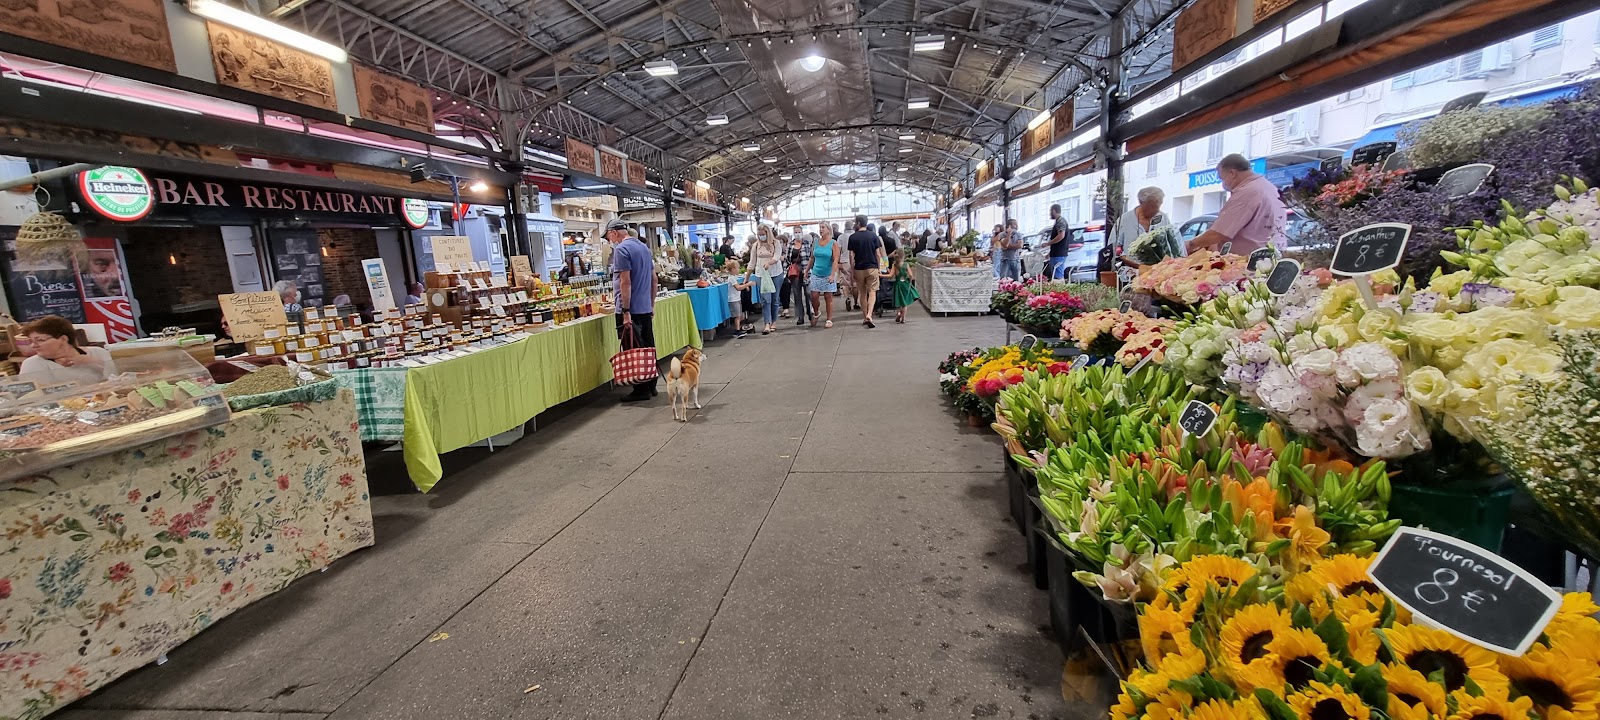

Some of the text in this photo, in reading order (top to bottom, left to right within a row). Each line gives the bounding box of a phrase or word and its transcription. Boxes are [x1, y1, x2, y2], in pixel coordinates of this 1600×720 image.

[92, 182, 147, 194] Heineken
[154, 178, 394, 215] BAR RESTAURANT
[1354, 243, 1388, 268] 8 €
[1183, 416, 1195, 429] 6
[1413, 536, 1516, 591] Tournesol
[1413, 567, 1498, 613] 8 €
